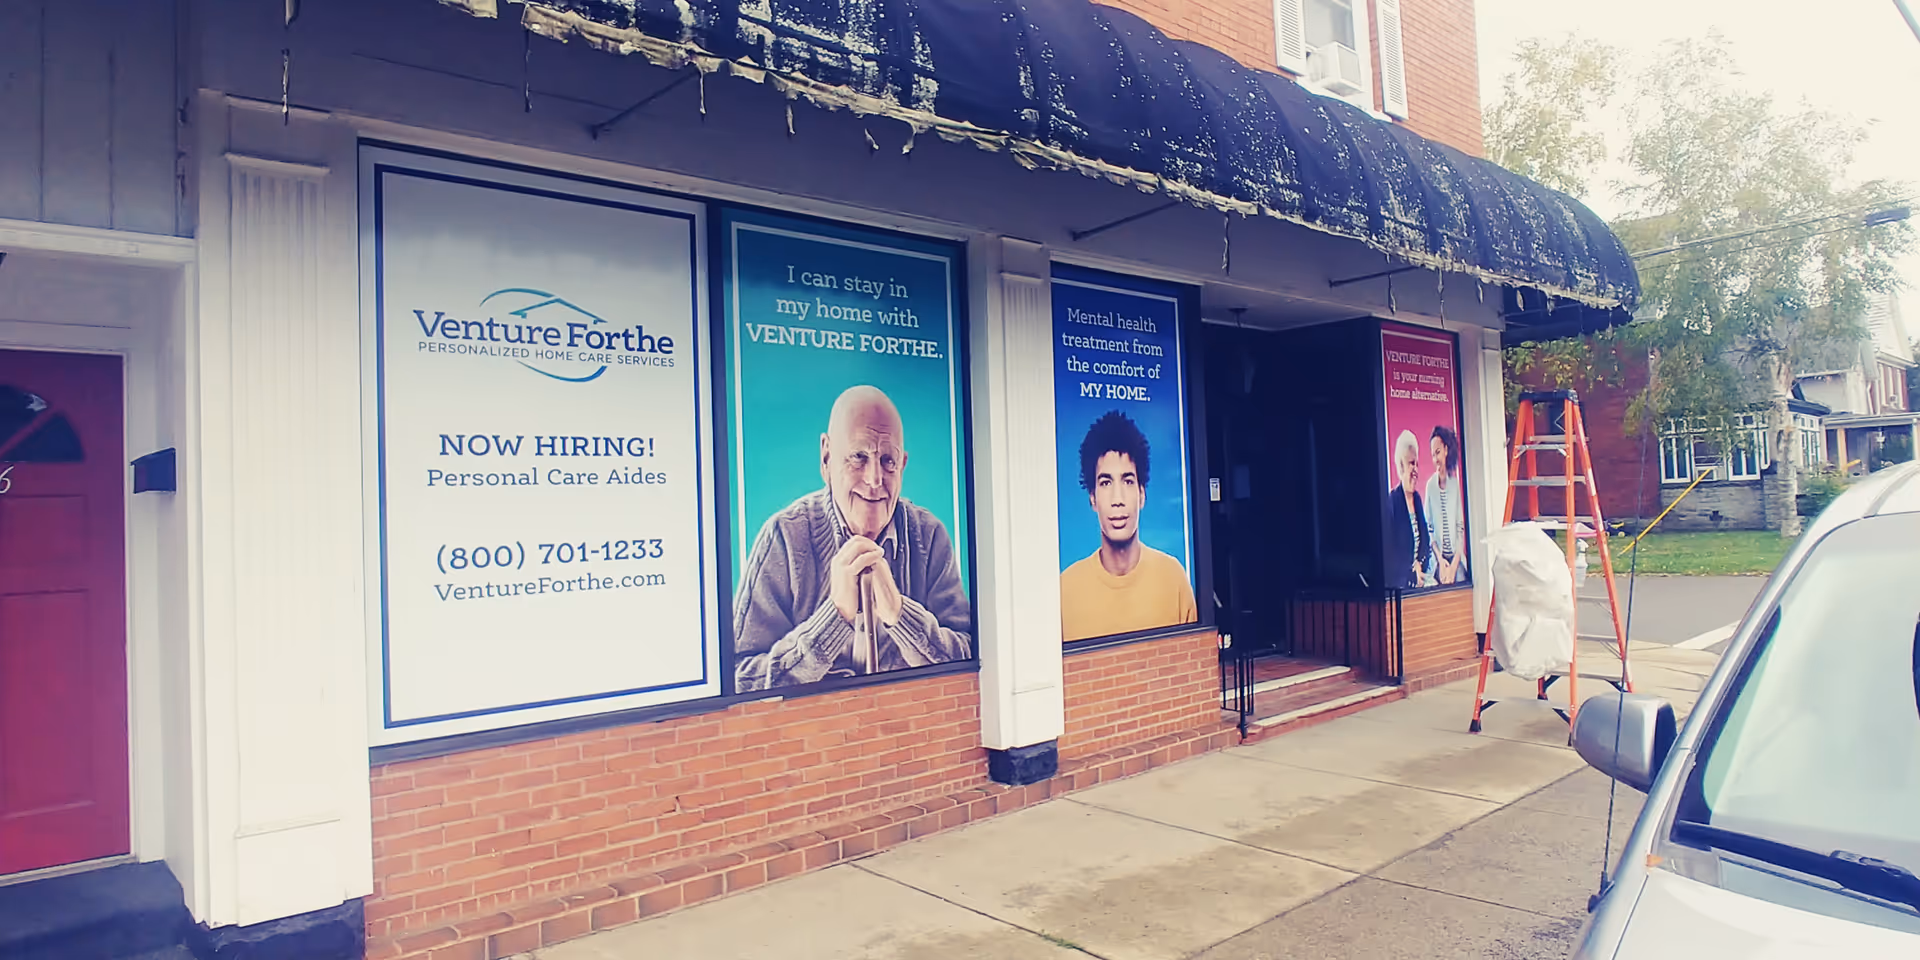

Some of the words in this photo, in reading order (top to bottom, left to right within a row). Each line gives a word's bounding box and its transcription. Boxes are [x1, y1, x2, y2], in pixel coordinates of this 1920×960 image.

[787, 265, 795, 283] I
[801, 271, 838, 289] can
[844, 276, 884, 300] stay
[889, 277, 908, 298] in
[776, 298, 811, 320] my
[816, 297, 873, 323] home
[877, 307, 919, 328] with
[1067, 307, 1114, 328] Mental
[1117, 313, 1157, 333] health
[412, 309, 561, 346] Venture
[566, 322, 674, 354] Forthe
[745, 322, 854, 351] VENTURE
[859, 333, 943, 359] FORTHE.
[418, 341, 530, 359] PERSONALIZED
[535, 349, 573, 361] HOME
[578, 352, 613, 364] CARE
[617, 354, 675, 367] SERVICES
[1062, 332, 1130, 353] treatment
[1132, 339, 1163, 357] from
[1385, 349, 1421, 365] VENTURE
[1067, 355, 1089, 373] the
[1093, 360, 1145, 378] comfort
[1148, 364, 1161, 379] of
[1393, 367, 1400, 380] is
[1401, 372, 1418, 384] your
[1080, 382, 1103, 398] MY
[1106, 384, 1151, 402] HOME.
[1390, 385, 1411, 399] home
[439, 434, 524, 456] NOW
[535, 436, 655, 457] HIRING!
[427, 467, 539, 487] Personal
[548, 469, 599, 486] Care
[606, 467, 667, 485] Aides
[437, 541, 525, 574] (800)
[538, 538, 664, 564] 701-1233
[434, 572, 666, 602] VentureForthe.com
